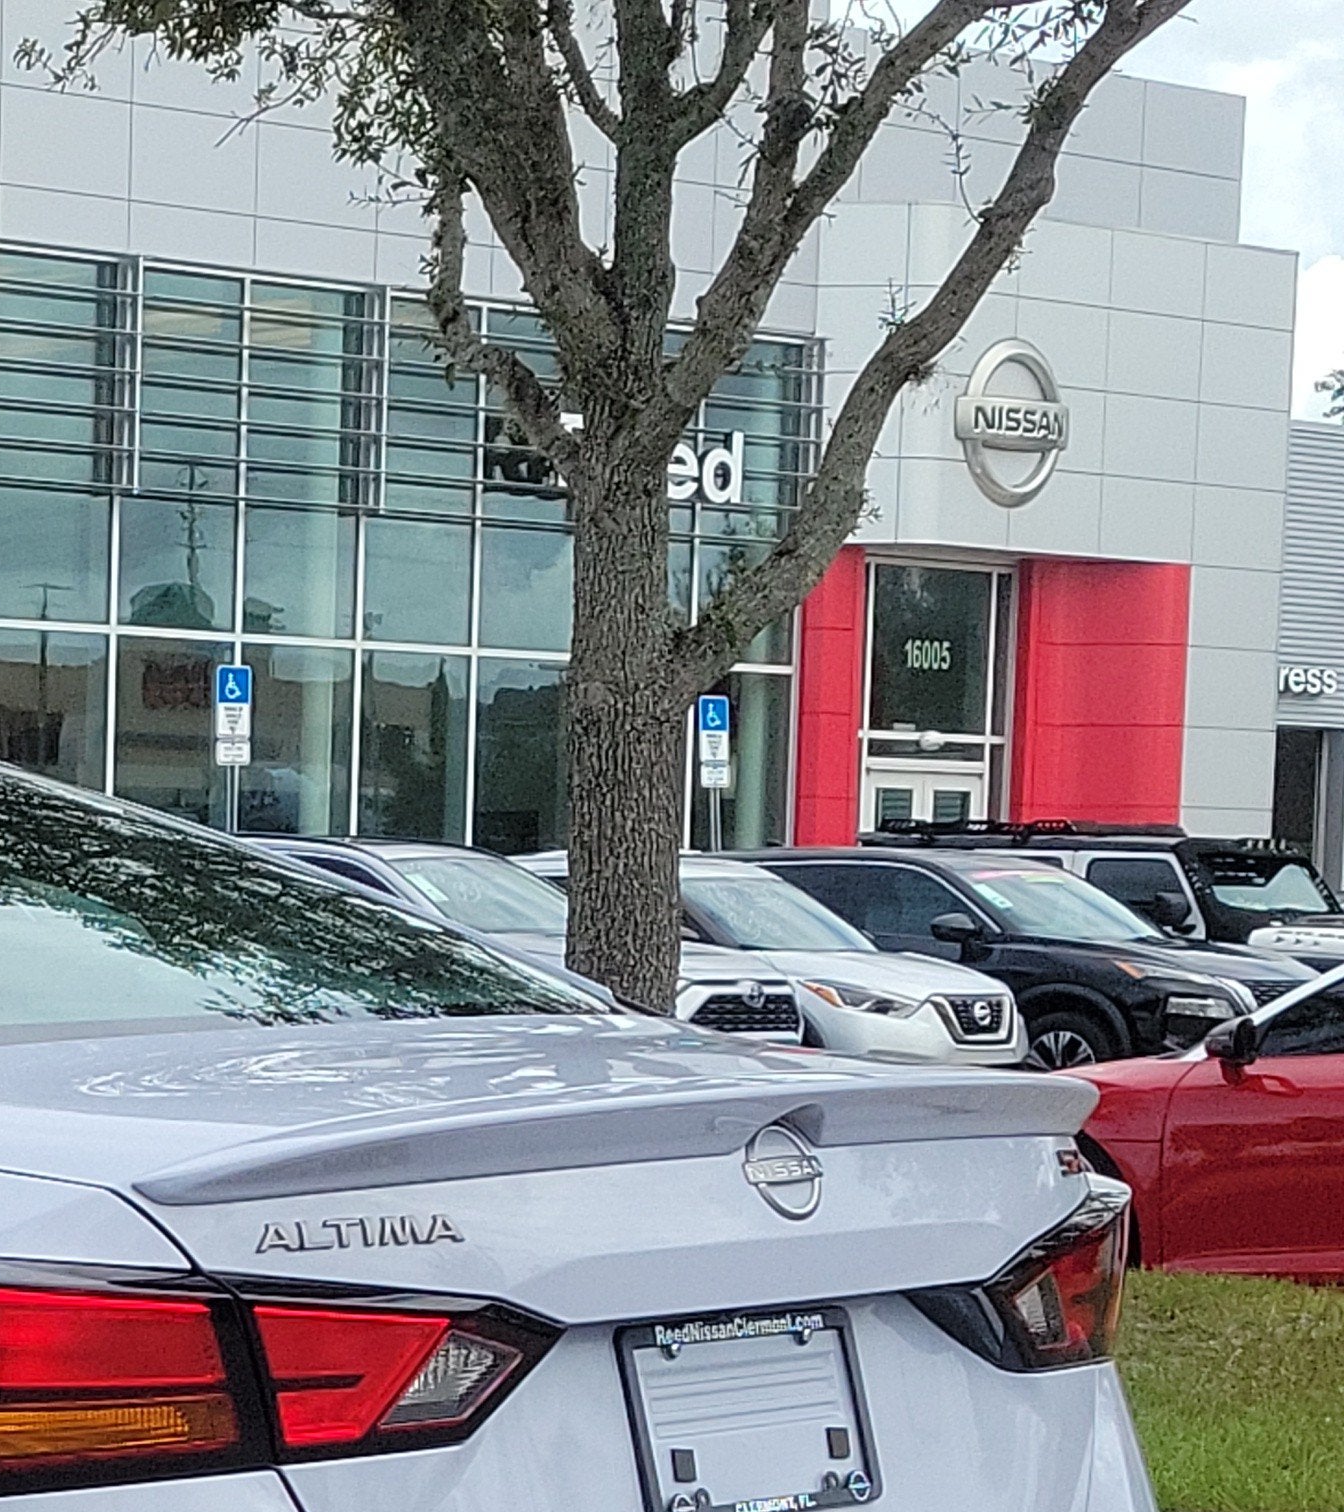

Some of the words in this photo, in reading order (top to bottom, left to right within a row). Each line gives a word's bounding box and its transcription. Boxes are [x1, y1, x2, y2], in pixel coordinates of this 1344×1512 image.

[973, 405, 1064, 437] NISSAN
[904, 638, 951, 670] 16005
[255, 1214, 465, 1253] ALTIMA
